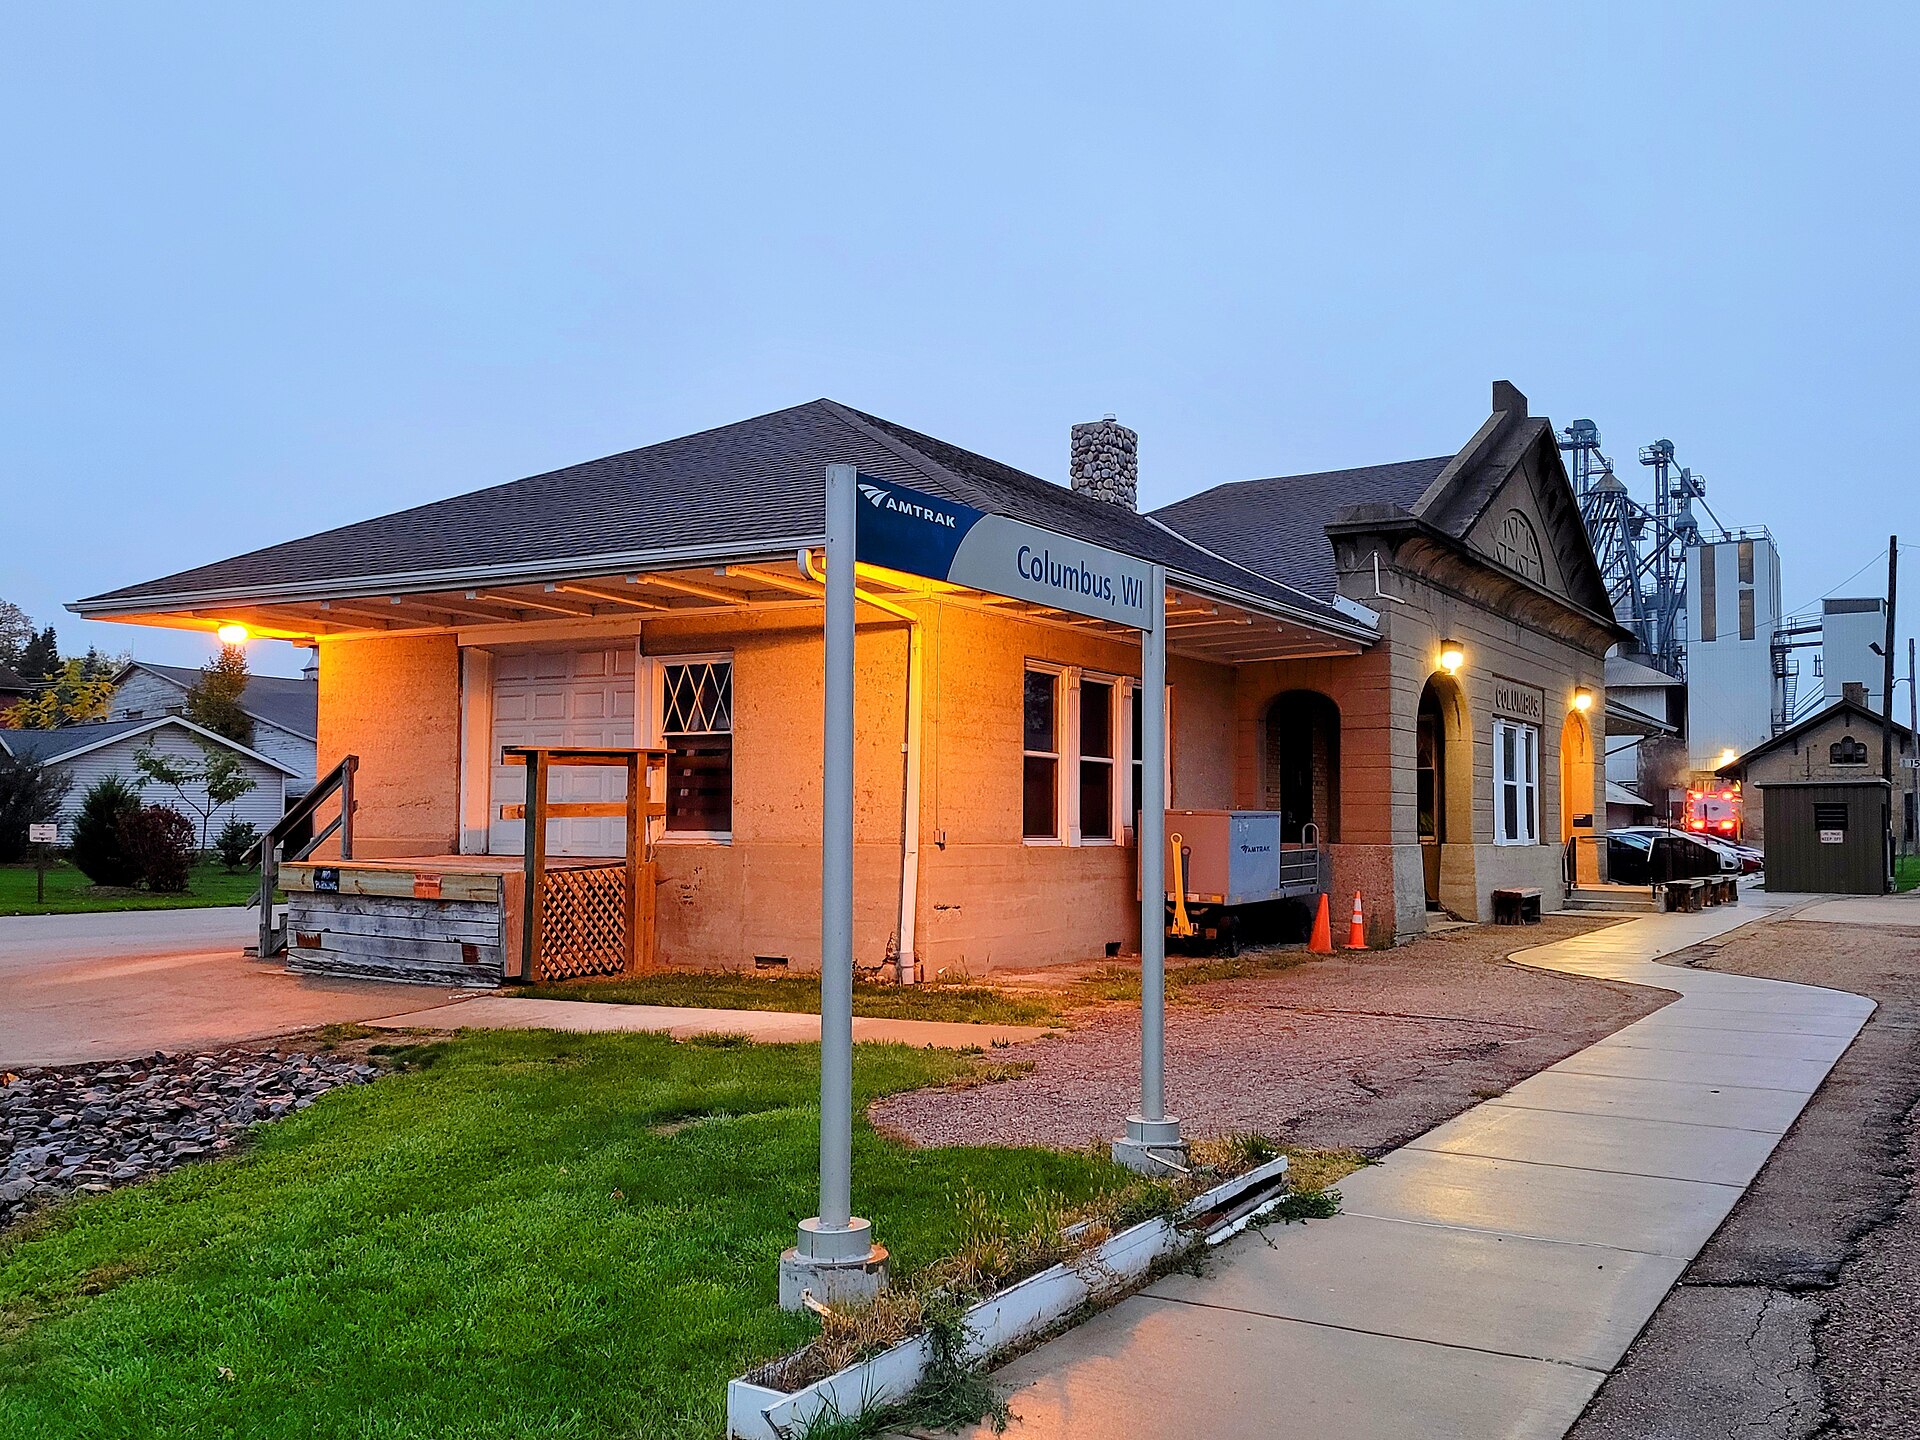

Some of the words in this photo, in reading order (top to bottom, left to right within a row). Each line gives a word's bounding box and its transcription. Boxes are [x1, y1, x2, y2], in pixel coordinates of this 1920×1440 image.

[886, 497, 957, 529] AMTRAK
[1016, 544, 1116, 607] Columbus,
[1121, 574, 1144, 609] WI
[1248, 845, 1271, 853] AMTRAK
[321, 870, 331, 880] NO
[315, 880, 338, 890] PARKING
